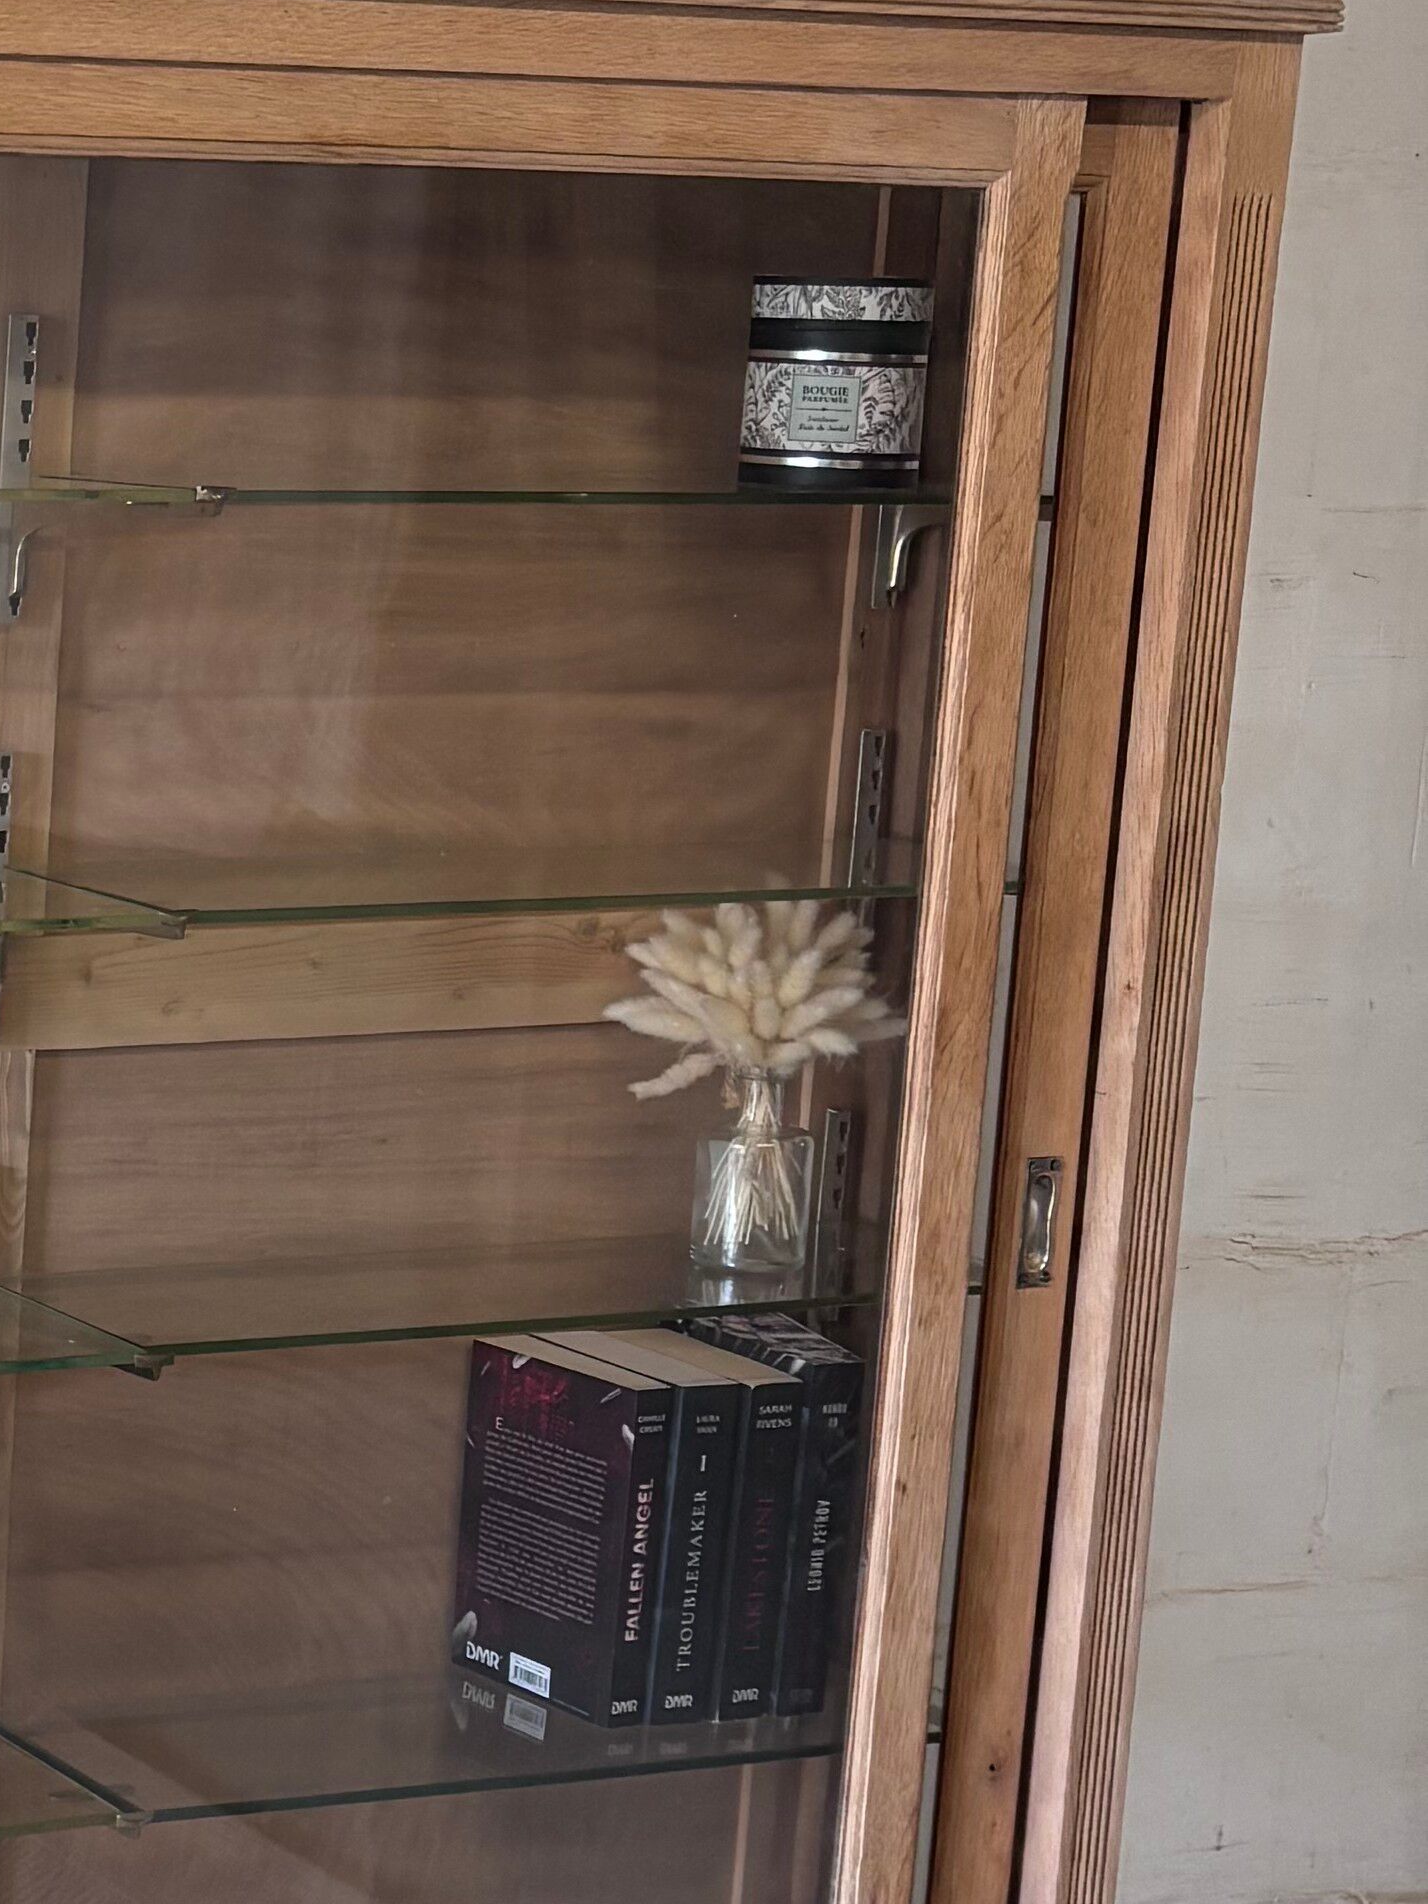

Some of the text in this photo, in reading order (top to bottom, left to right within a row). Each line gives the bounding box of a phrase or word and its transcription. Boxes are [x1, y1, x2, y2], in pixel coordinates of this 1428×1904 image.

[802, 385, 849, 397] BOUGIE
[624, 1478, 654, 1642] FALLEN ANGEL
[675, 1490, 707, 1672] TROUBLEMAKER
[465, 1640, 500, 1671] DMR
[664, 1694, 693, 1709] DMR
[731, 1687, 759, 1704] DMR
[611, 1699, 638, 1715] DMR
